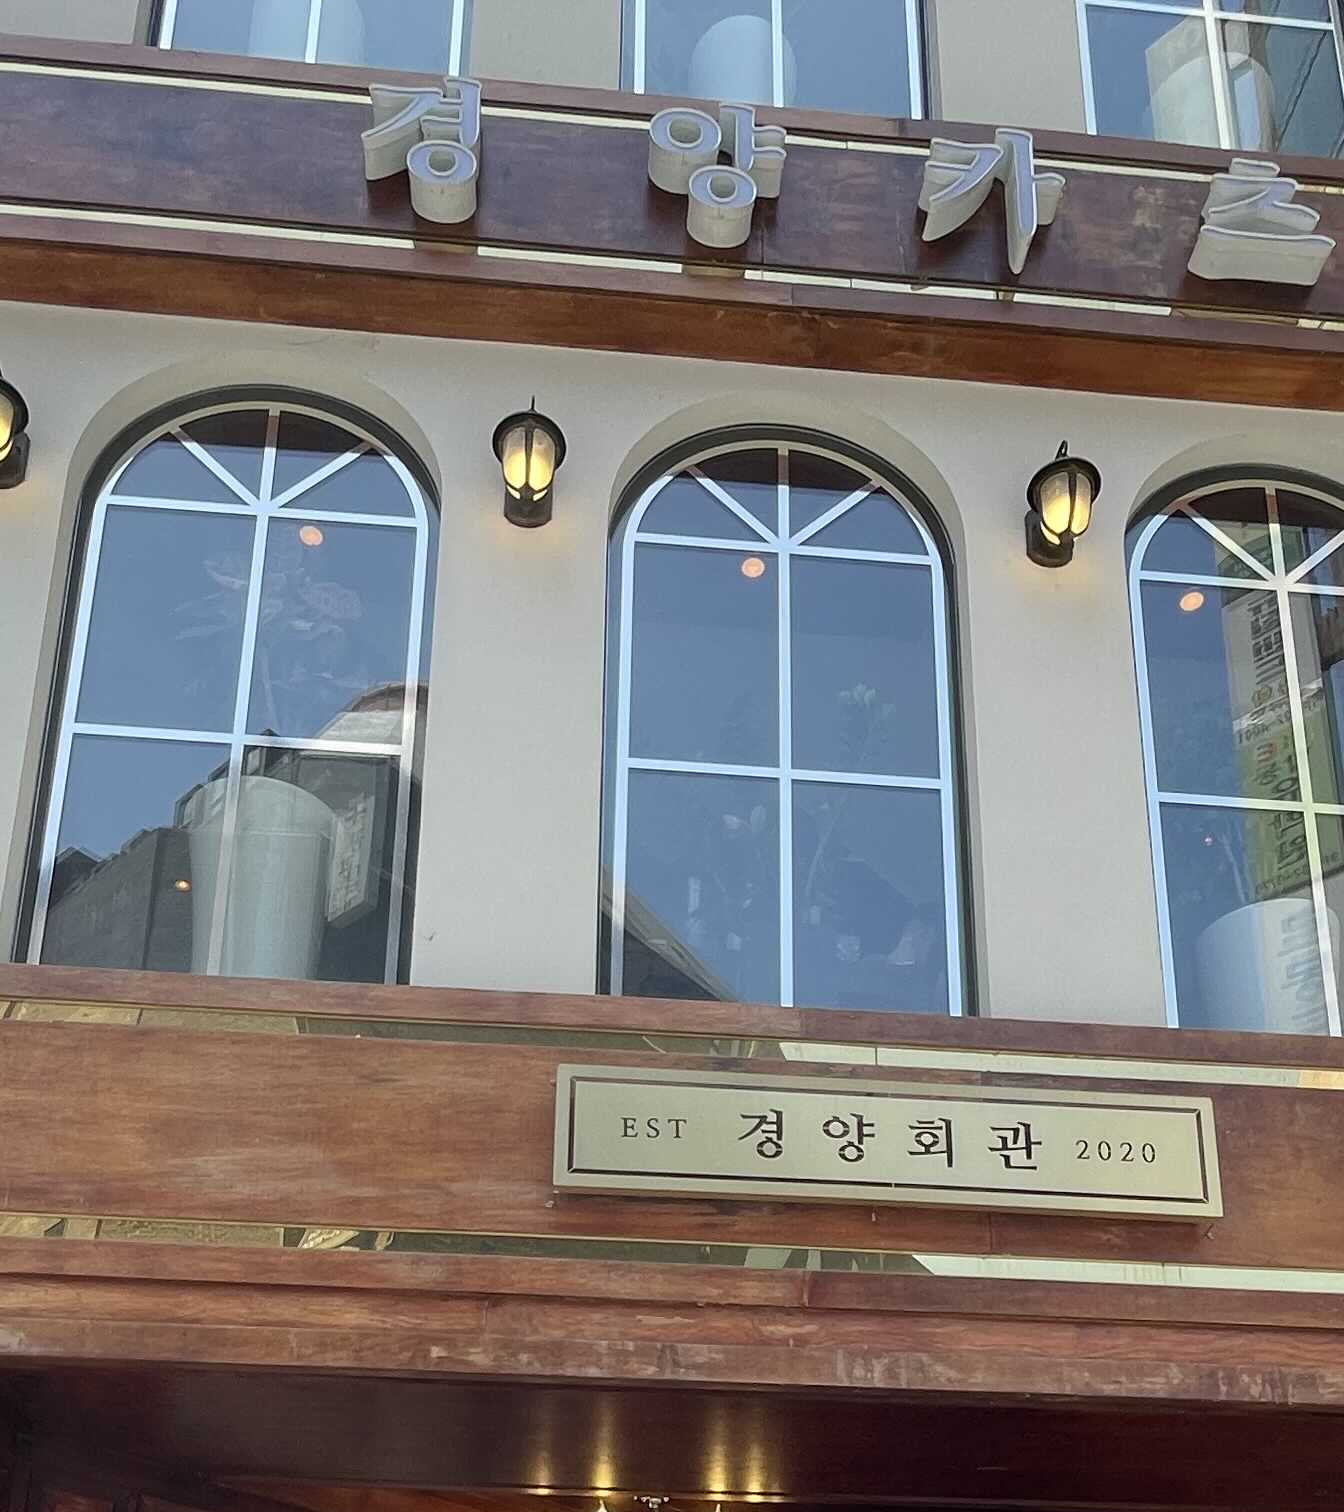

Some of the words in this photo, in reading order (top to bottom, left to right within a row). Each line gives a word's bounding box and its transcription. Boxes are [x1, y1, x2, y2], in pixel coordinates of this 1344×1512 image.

[361, 76, 1337, 286] 경양카츠
[619, 1114, 689, 1141] EST
[737, 1108, 1043, 1172] 경양회관
[1074, 1138, 1159, 1165] 2020
